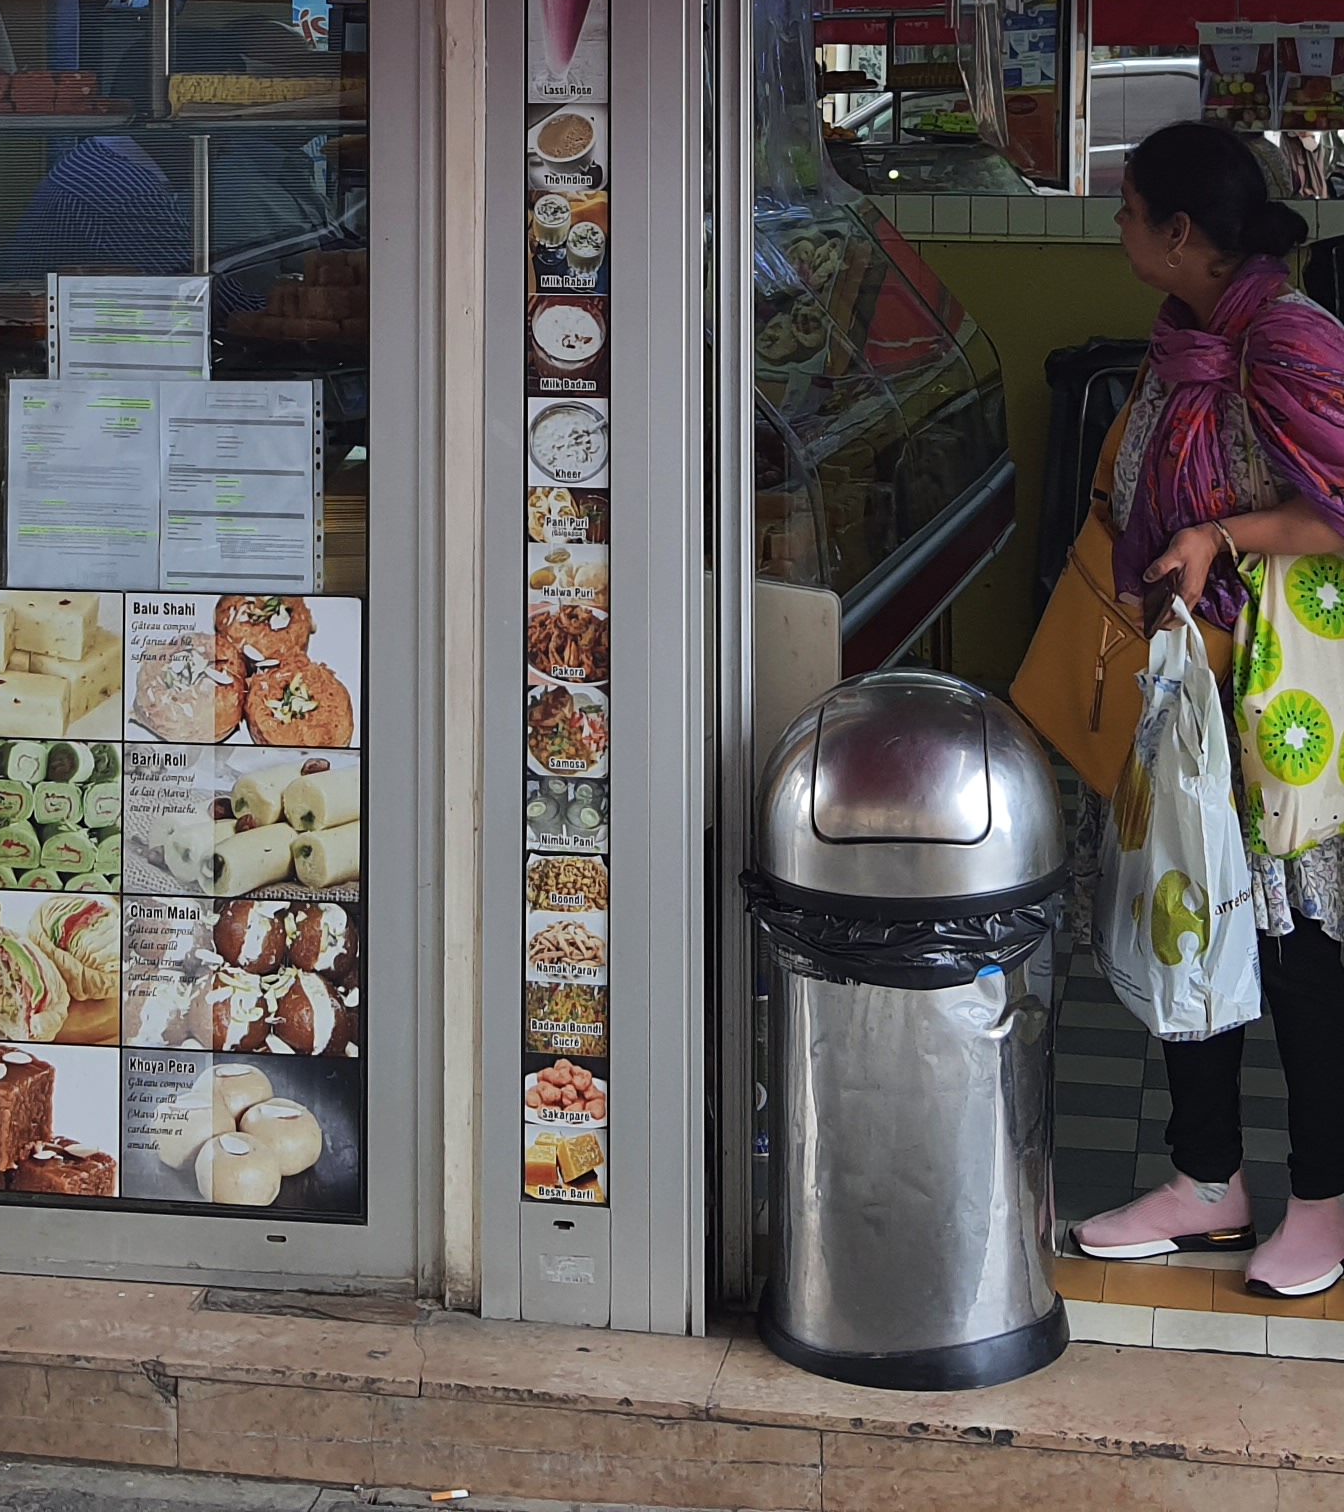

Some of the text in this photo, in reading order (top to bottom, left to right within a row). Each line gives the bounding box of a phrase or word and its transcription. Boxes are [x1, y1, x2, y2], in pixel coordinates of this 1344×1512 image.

[544, 85, 592, 95] Lassi Rose
[563, 175, 592, 185] Indien
[541, 276, 594, 287] Milk Rabari
[541, 379, 595, 389] Milk Badam
[556, 469, 581, 478] Kheer
[546, 517, 588, 527] Pani Puri
[544, 587, 593, 597] Halwa Puri
[134, 602, 195, 616] Balu Shahi
[552, 666, 584, 676] Pakora
[132, 753, 186, 767] Barfi Roll
[550, 758, 585, 768] Samosa
[542, 835, 594, 847] Nimbu Pani
[551, 894, 584, 905] Boondi
[1215, 887, 1251, 915] arrefo
[131, 905, 200, 920] Cham Malai
[536, 963, 597, 977] Namak Paray
[532, 1020, 602, 1034] Badana Boondi
[130, 1058, 195, 1074] Khoya Pera
[539, 1186, 593, 1199] Besan Barfi
